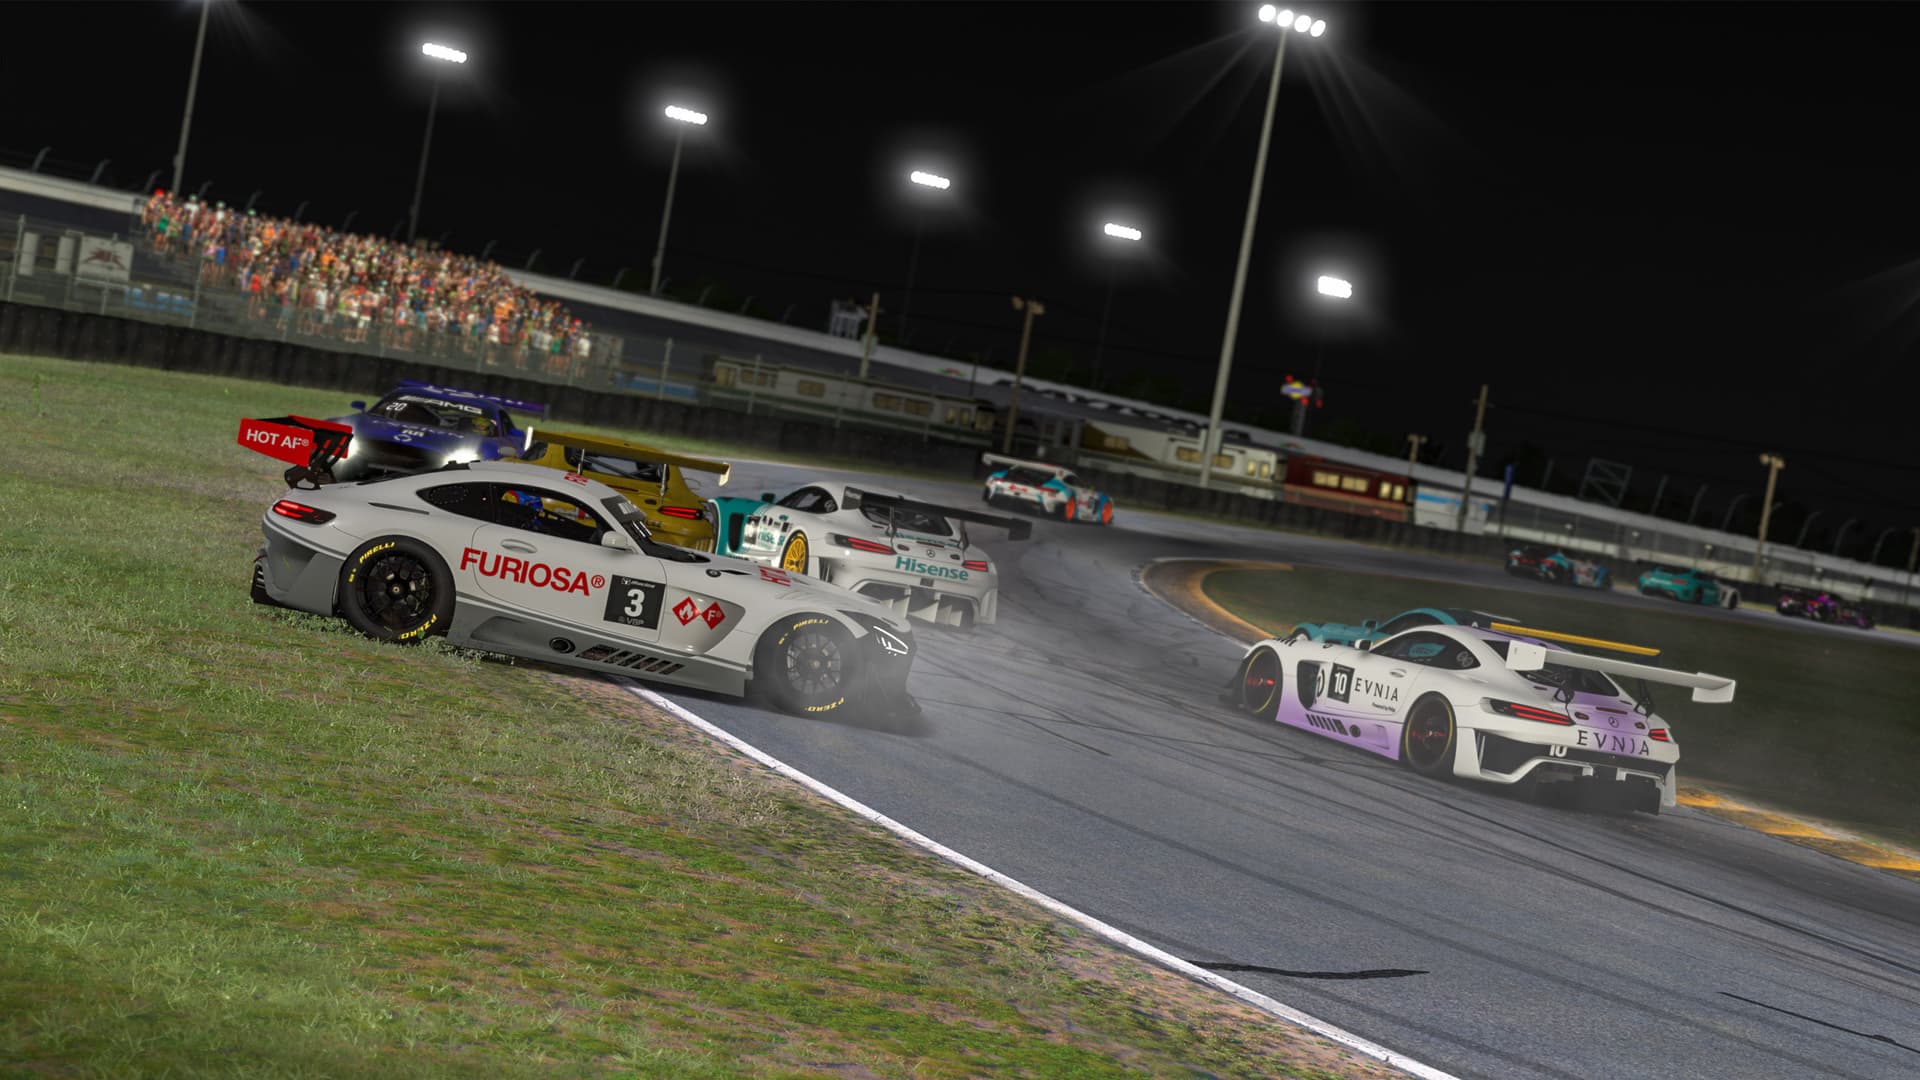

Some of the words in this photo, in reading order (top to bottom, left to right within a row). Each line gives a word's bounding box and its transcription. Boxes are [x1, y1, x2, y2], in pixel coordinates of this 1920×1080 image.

[385, 402, 407, 412] 20
[422, 399, 482, 415] AMG
[246, 428, 280, 445] HOT
[360, 541, 396, 564] PIRELLI
[460, 547, 606, 597] FURIOSA®
[895, 556, 969, 581] Hisense
[624, 588, 646, 618] 3
[1334, 671, 1348, 695] 10
[1354, 677, 1399, 702] EVNIA
[1576, 729, 1650, 756] EVNIA
